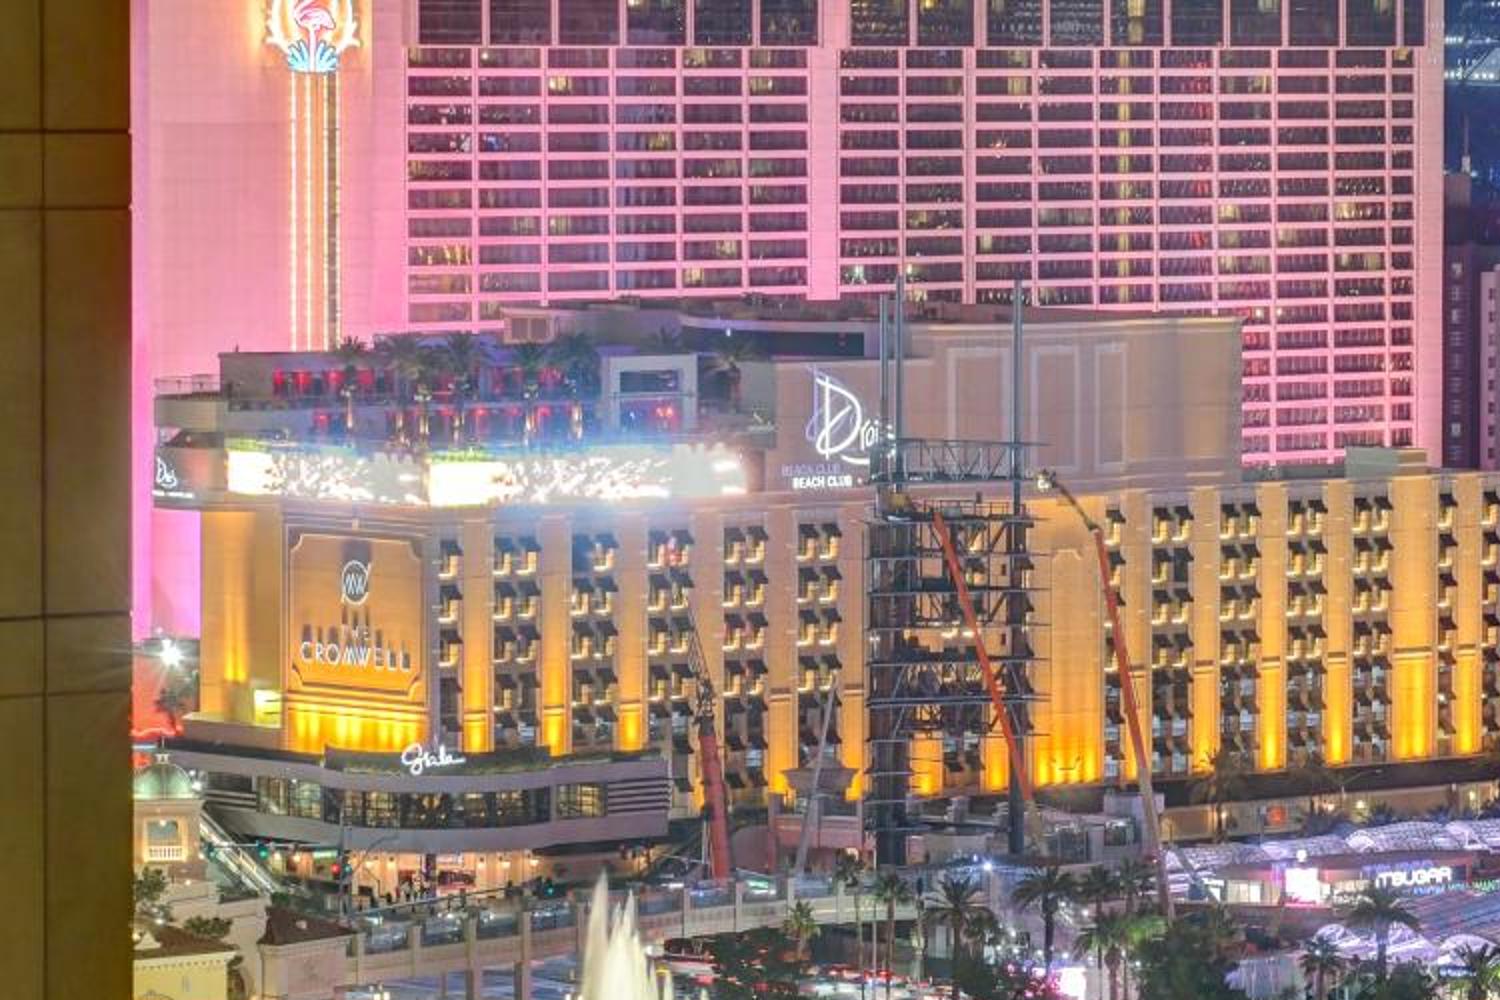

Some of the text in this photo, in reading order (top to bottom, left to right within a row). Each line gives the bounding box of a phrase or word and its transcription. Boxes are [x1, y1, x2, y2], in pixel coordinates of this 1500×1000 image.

[792, 475, 853, 489] BEACH CLUB
[301, 641, 411, 672] CROMWELL
